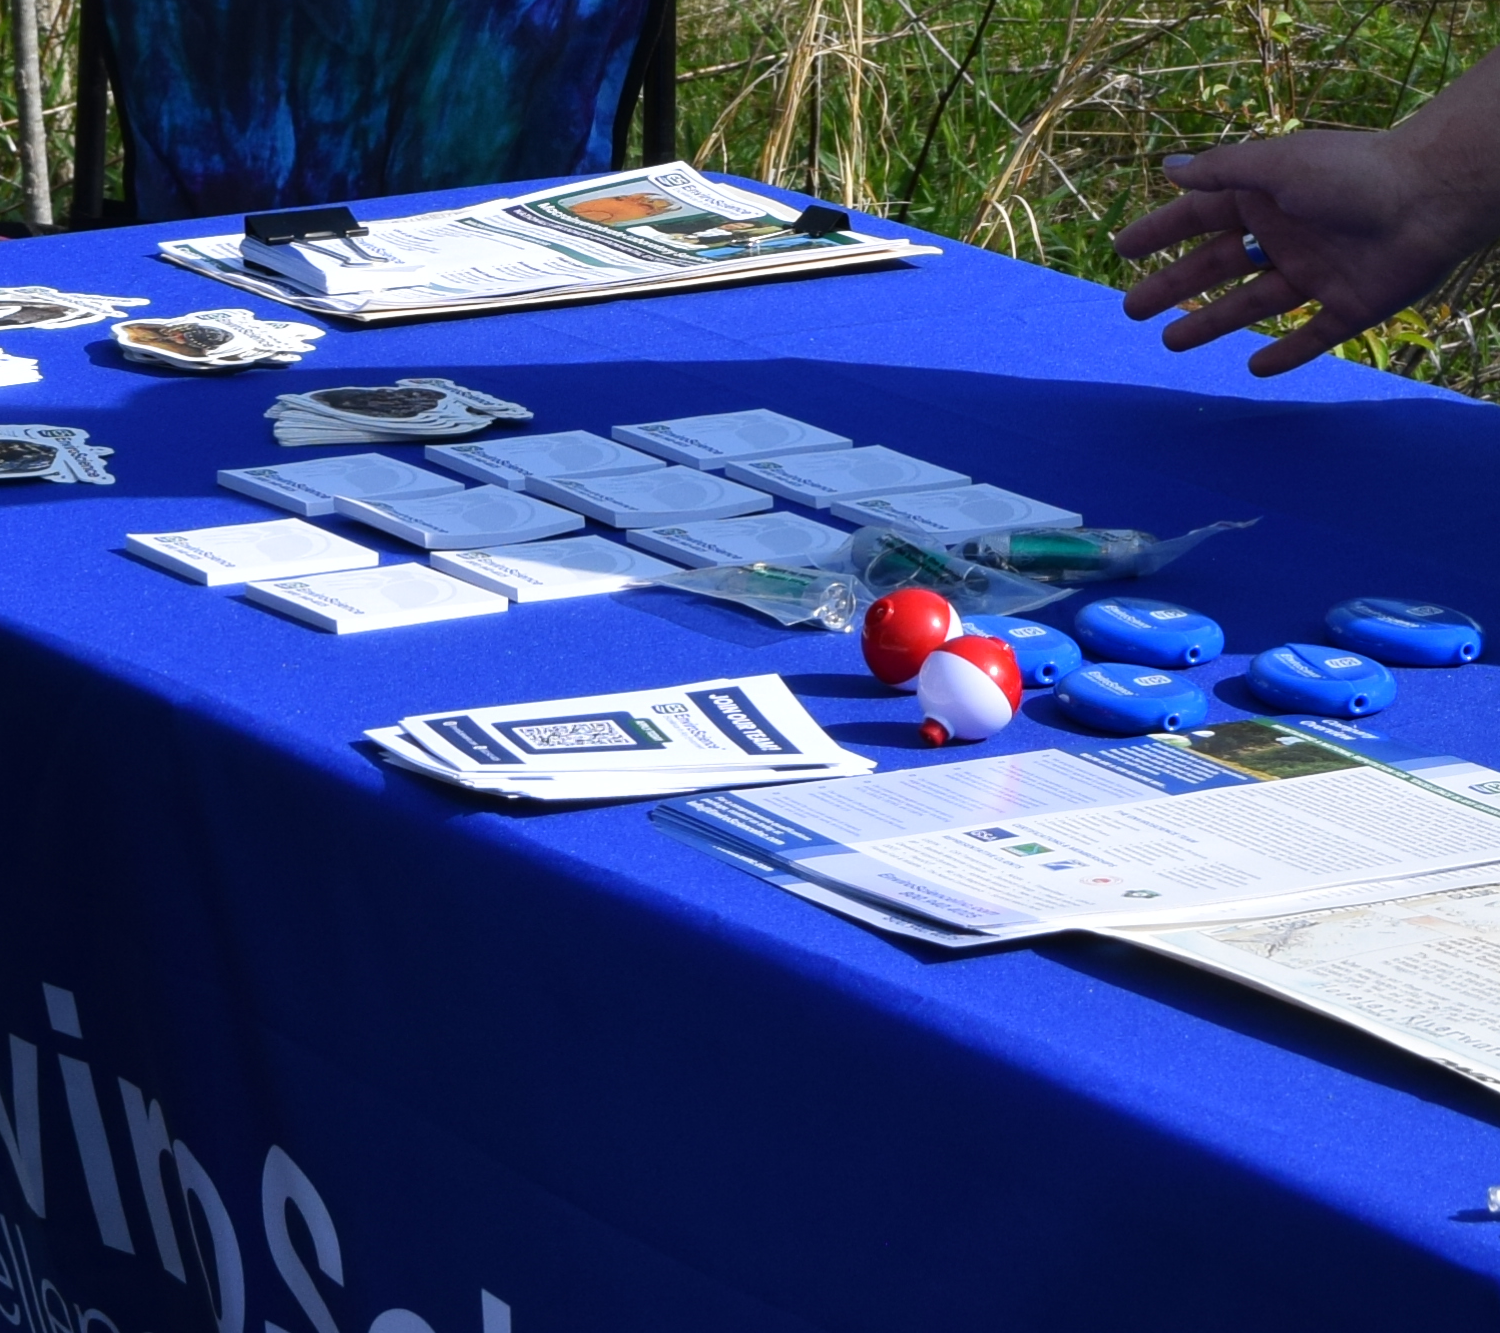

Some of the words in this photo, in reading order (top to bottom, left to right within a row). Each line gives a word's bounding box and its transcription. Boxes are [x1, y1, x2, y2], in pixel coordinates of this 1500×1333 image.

[708, 693, 743, 715] JOIN
[726, 713, 757, 732] OUR
[742, 727, 783, 752] TEAM!
[1299, 720, 1357, 741] Overview
[1321, 719, 1380, 740] Company
